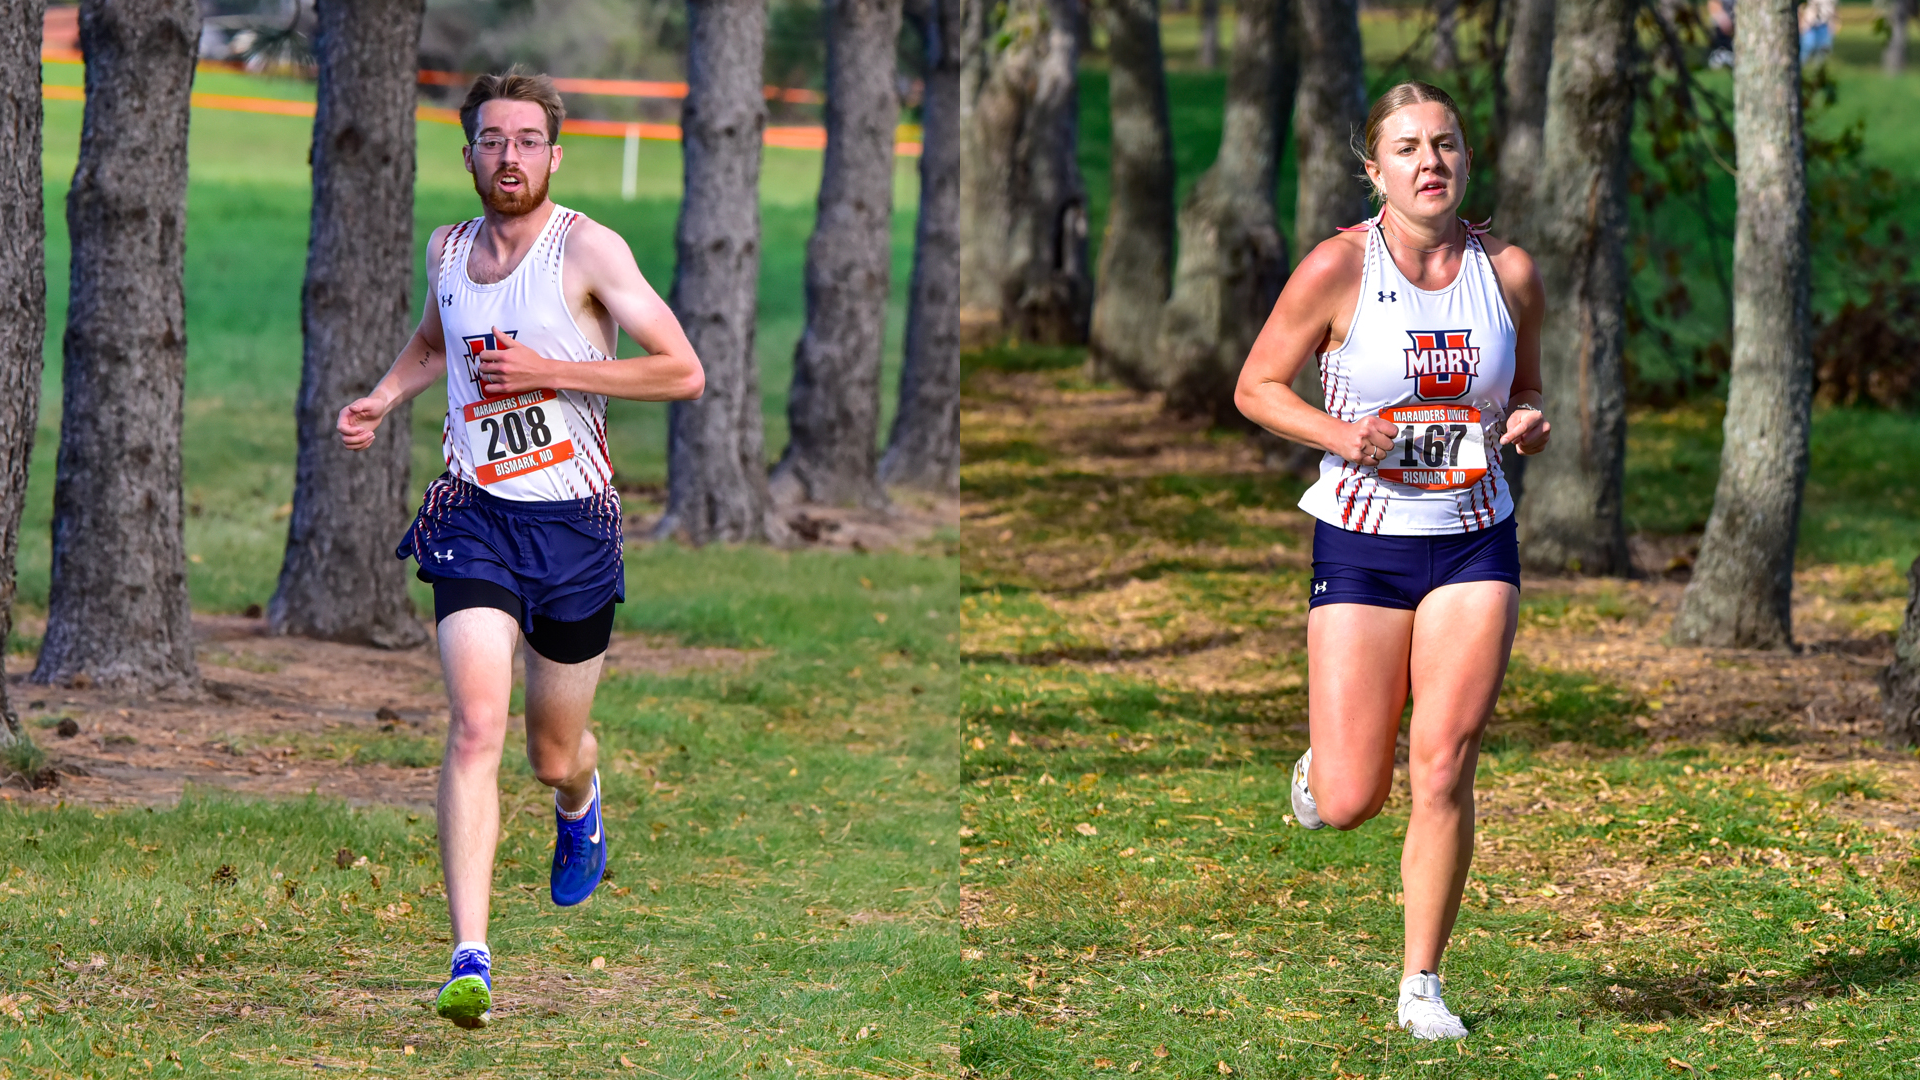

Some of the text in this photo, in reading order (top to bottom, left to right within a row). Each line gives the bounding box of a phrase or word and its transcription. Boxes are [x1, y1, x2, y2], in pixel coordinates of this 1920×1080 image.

[1403, 347, 1480, 380] MARY
[473, 390, 545, 418] MARAUDERS INVITE
[1393, 409, 1446, 422] MARAUDERS
[481, 405, 552, 461] 208
[1399, 424, 1468, 468] 167
[494, 449, 554, 477] BISMARK, ND
[1402, 471, 1466, 485] BISMARK, ND
